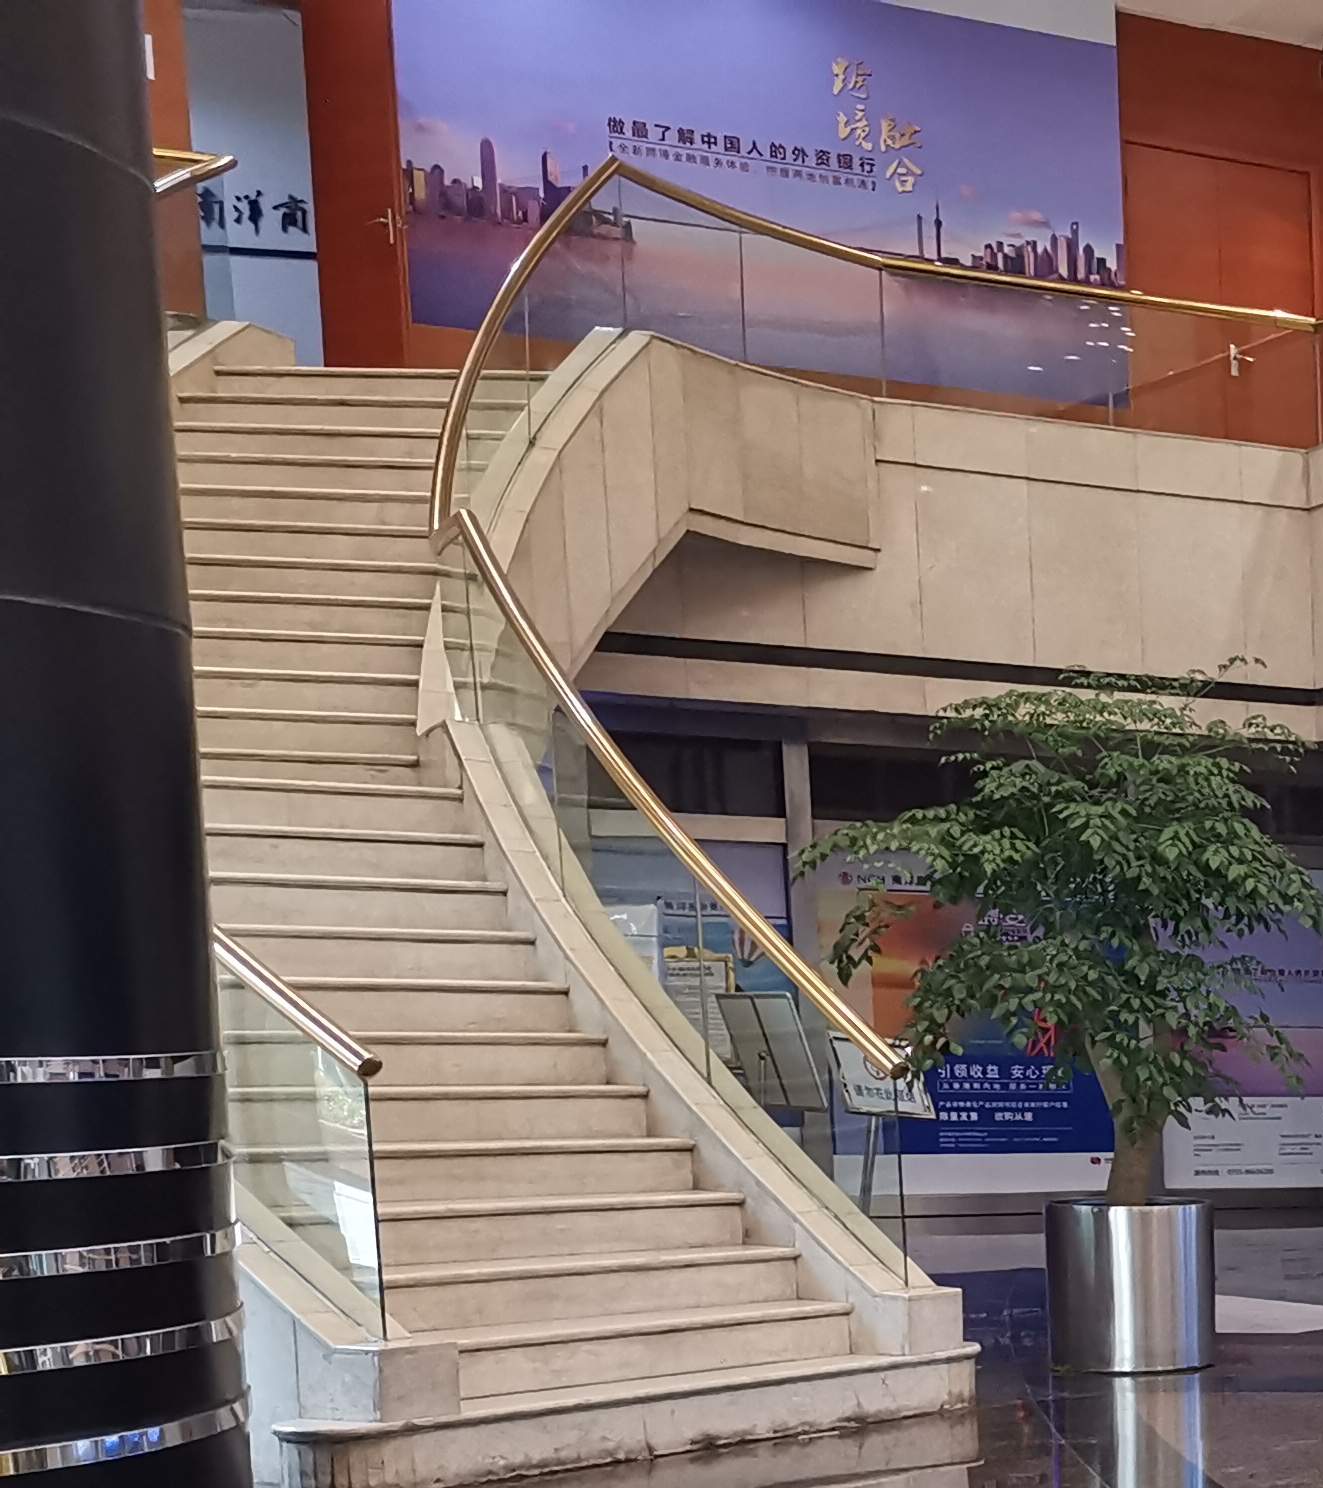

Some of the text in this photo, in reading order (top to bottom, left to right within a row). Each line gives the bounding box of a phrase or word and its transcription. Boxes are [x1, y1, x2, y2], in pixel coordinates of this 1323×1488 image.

[607, 116, 877, 174] 做最了解中国人的外资银行
